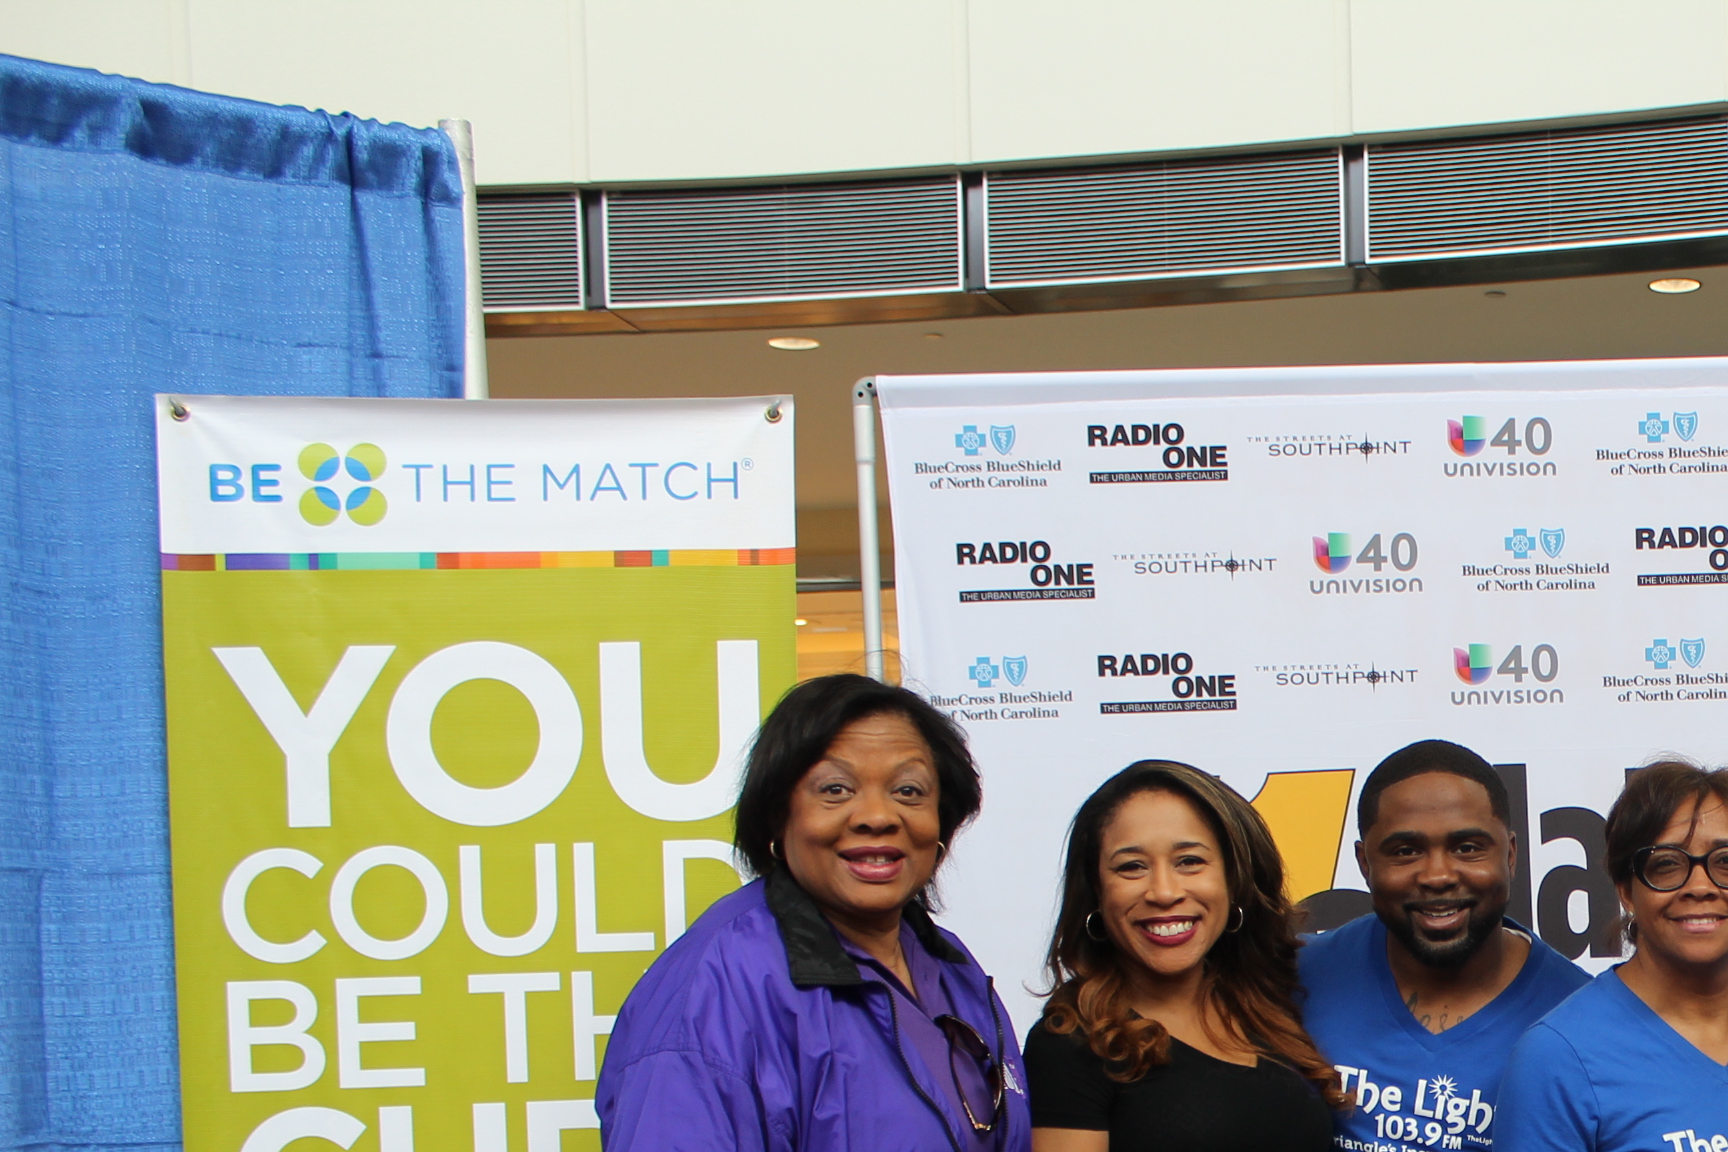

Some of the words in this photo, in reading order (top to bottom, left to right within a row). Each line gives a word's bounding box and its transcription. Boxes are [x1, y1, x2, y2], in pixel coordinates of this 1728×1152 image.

[1087, 422, 1185, 448] RADIO
[1490, 416, 1552, 457] 40
[1162, 445, 1228, 469] ONE
[1596, 447, 1664, 461] BlueCross
[914, 461, 982, 474] BlueCross
[986, 459, 1062, 472] BlueShield
[1092, 473, 1109, 482] THE
[1112, 472, 1142, 482] URBAN
[1145, 472, 1172, 481] MEDIA
[1175, 470, 1225, 480] SPECIALIST
[1443, 459, 1557, 479] UNIVISION
[1610, 464, 1625, 475] of
[1628, 462, 1666, 475] North
[1669, 461, 1728, 474] Carolina
[208, 462, 284, 503] BE
[401, 463, 516, 503] THE
[929, 477, 944, 489] of
[946, 476, 985, 489] North
[987, 475, 1048, 488] Carolina
[956, 540, 1051, 566] RADIO
[1356, 532, 1418, 573] 40
[1030, 563, 1095, 587] ONE
[1462, 563, 1531, 577] BlueCross
[1535, 562, 1610, 576] BlueShield
[1309, 577, 1423, 595] UNIVISION
[1477, 580, 1492, 592] of
[1494, 579, 1533, 592] North
[1536, 577, 1596, 591] Carolina
[1097, 652, 1193, 678] RADIO
[1496, 643, 1558, 684] 40
[1171, 674, 1237, 699] ONE
[1603, 674, 1671, 688] BlueCross
[930, 693, 995, 707] BlueCross
[999, 690, 1073, 704] BlueShield
[1450, 688, 1564, 706] UNIVISION
[1618, 691, 1632, 702] of
[1635, 689, 1674, 702] North
[960, 708, 998, 721] North
[1000, 707, 1059, 720] Carolina
[210, 639, 760, 828] YOU
[225, 976, 426, 1093] BE
[1334, 1065, 1402, 1114] The
[1414, 1077, 1497, 1134] Ligh
[1374, 1113, 1442, 1146] 103.9
[1442, 1134, 1462, 1150] FM
